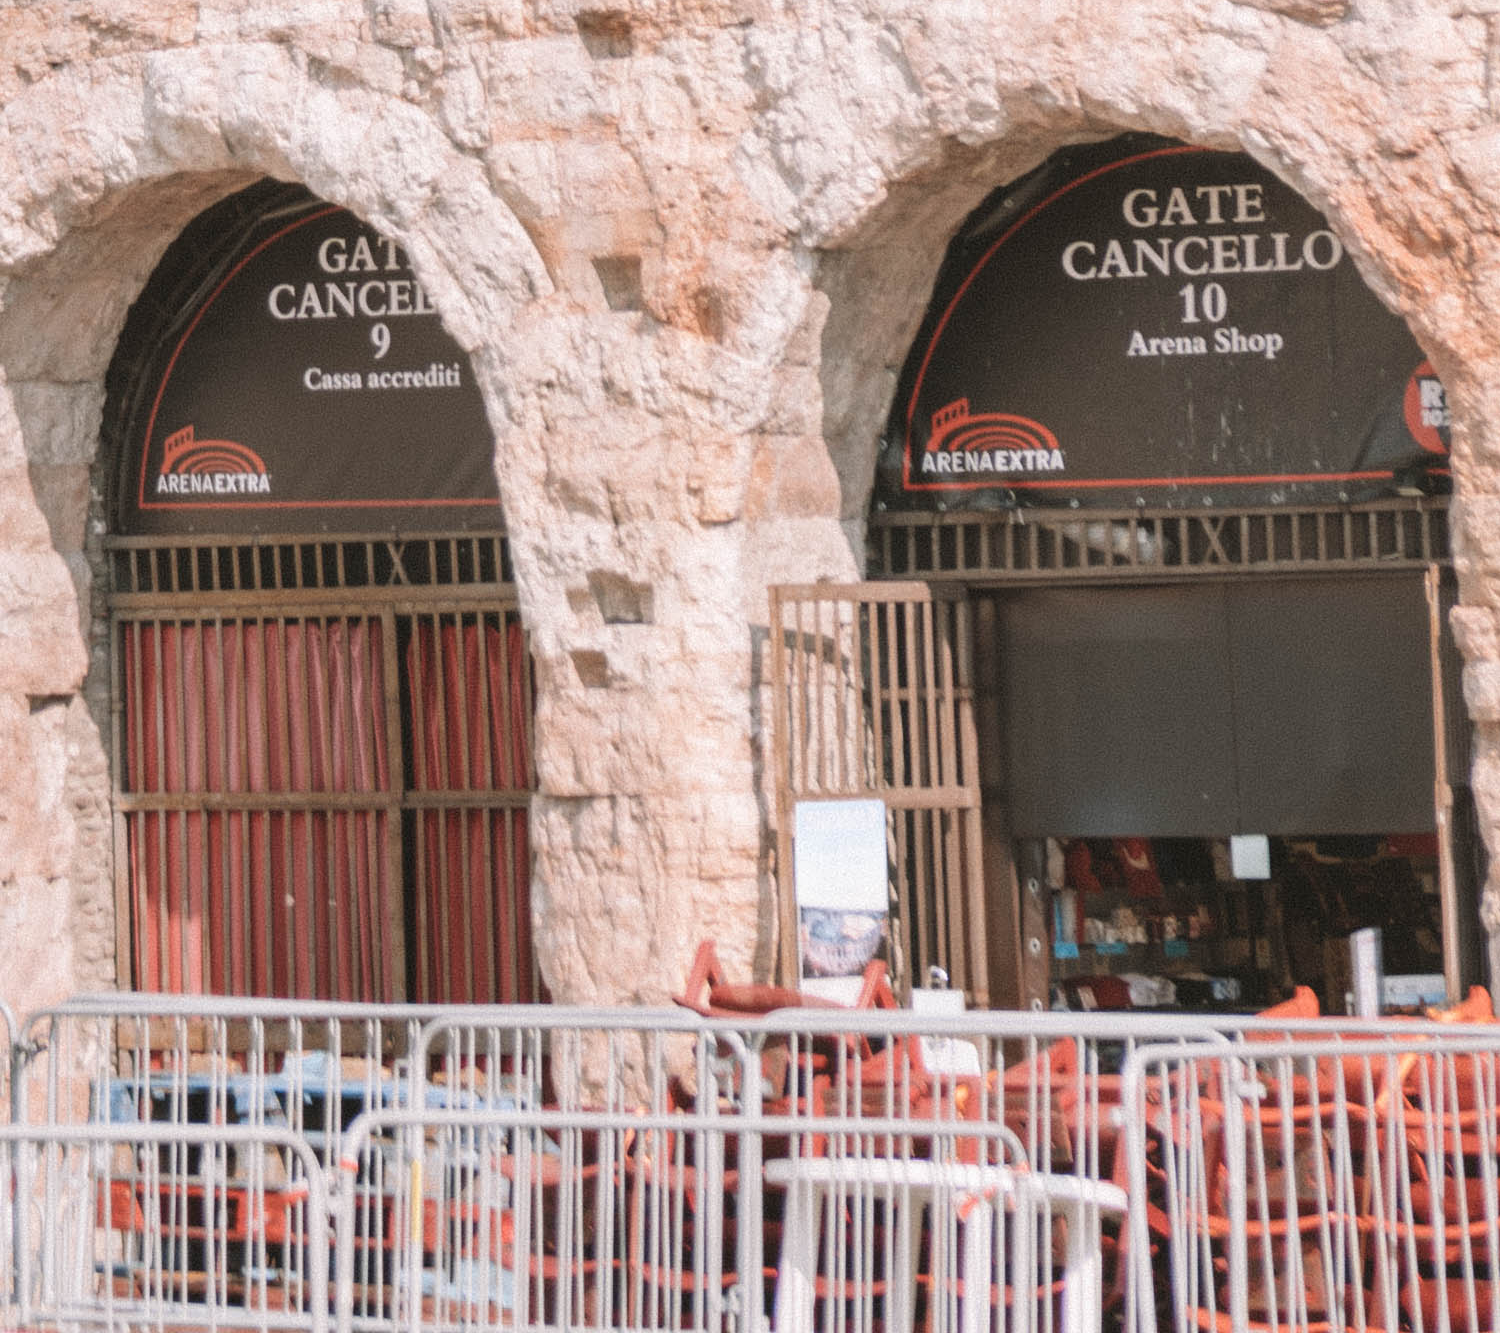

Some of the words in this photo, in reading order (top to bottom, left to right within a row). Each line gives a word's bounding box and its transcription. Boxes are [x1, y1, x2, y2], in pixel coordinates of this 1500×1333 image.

[1123, 184, 1265, 228] GATE
[318, 237, 416, 273] GAT
[1061, 230, 1343, 281] CANCELLO
[1178, 282, 1228, 324] 10
[369, 322, 392, 360] 9
[1127, 331, 1207, 357] Arena
[1213, 328, 1285, 360] Shop
[303, 367, 363, 391] Cassa
[368, 363, 461, 390] accrediti
[922, 449, 1066, 474] ARENAEXTRA
[157, 473, 271, 494] ARENAEXTRA
